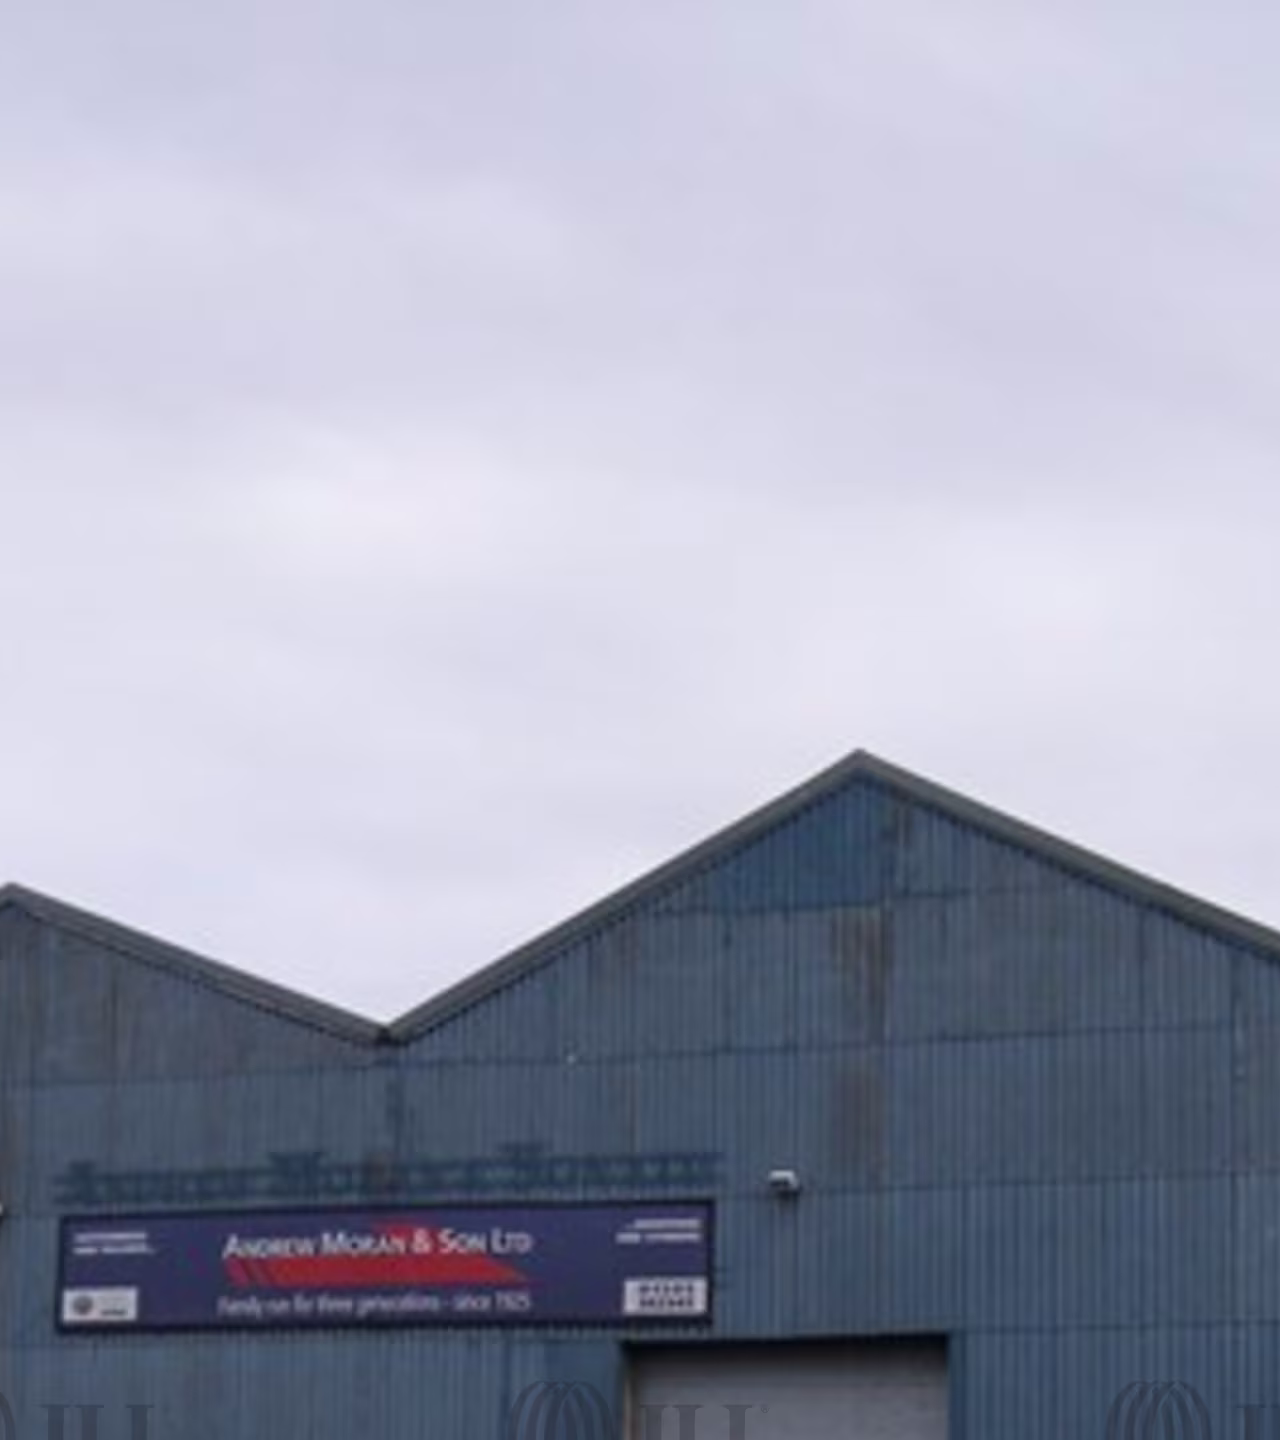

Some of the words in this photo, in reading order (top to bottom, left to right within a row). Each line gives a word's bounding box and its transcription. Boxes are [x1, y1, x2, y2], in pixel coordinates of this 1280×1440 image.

[222, 1232, 316, 1260] ANDREW
[321, 1230, 407, 1257] MORAN
[413, 1227, 433, 1254] &
[437, 1227, 488, 1254] SON
